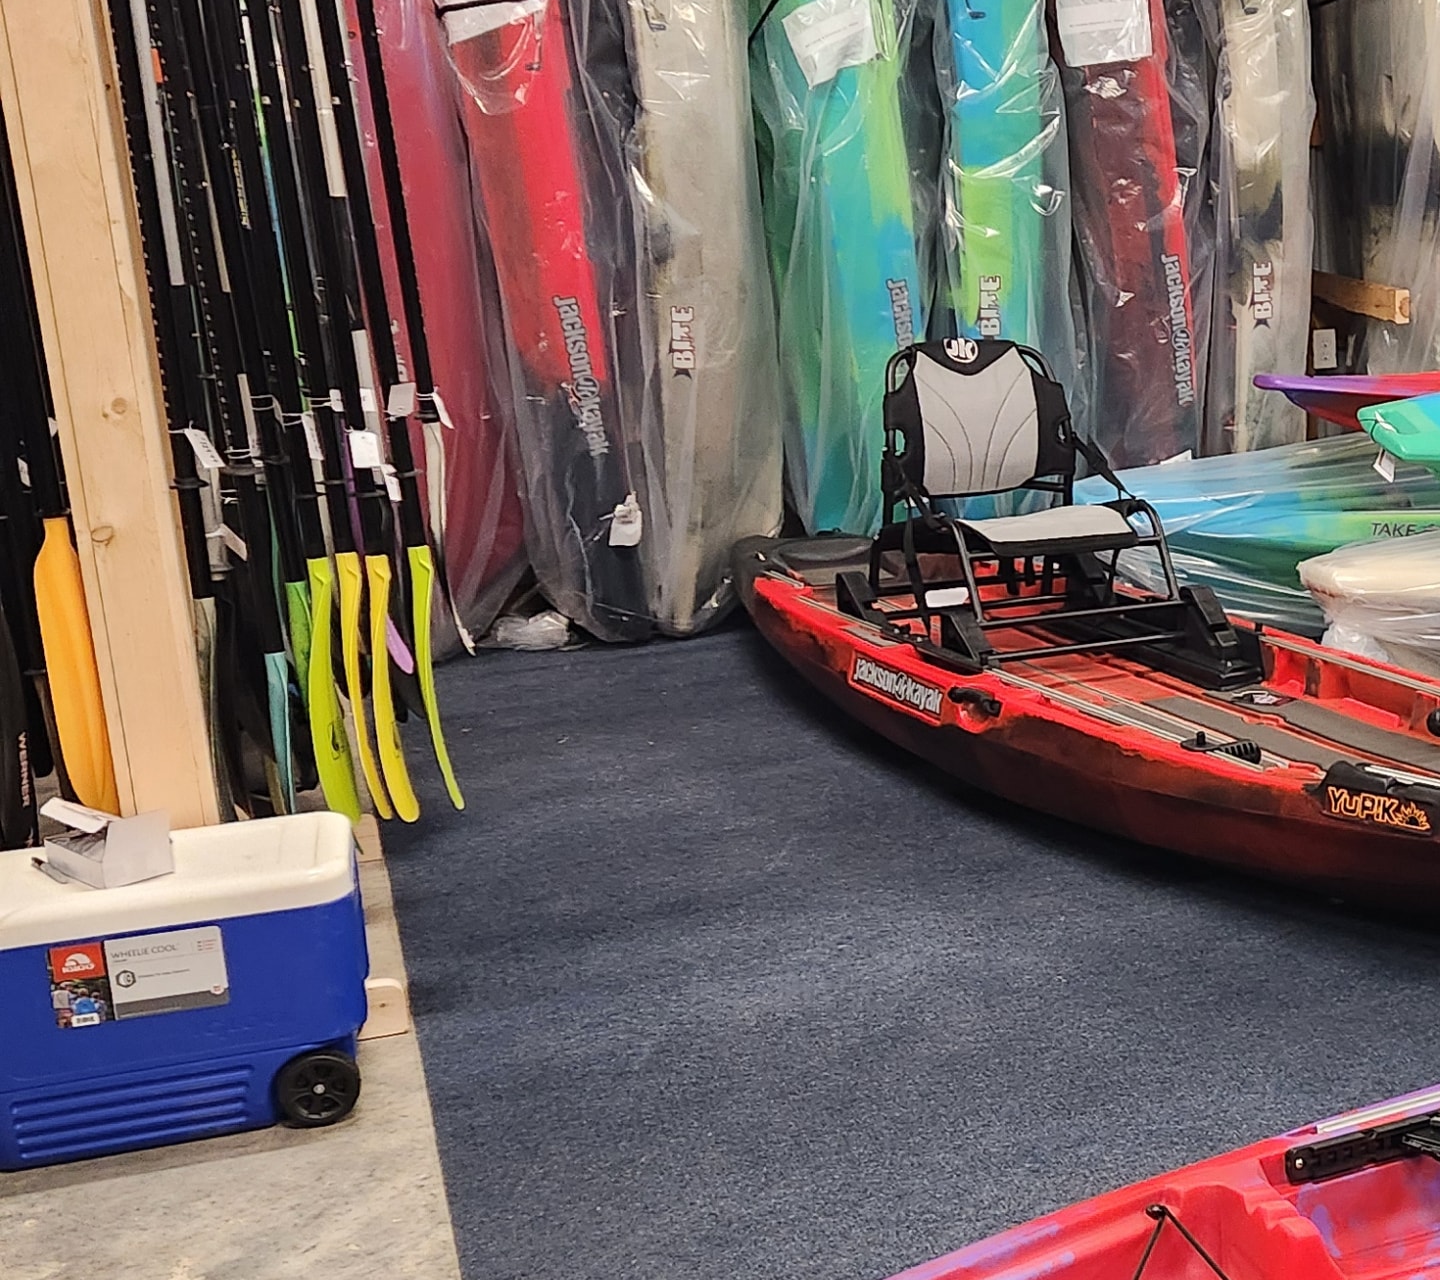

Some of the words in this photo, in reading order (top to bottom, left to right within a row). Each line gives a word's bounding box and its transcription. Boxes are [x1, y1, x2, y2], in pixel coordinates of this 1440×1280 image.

[979, 275, 1002, 336] BITE
[1252, 261, 1273, 320] BITE
[669, 305, 696, 370] BITE
[1371, 522, 1416, 537] TAKE
[17, 731, 31, 808] WERNER
[1327, 786, 1401, 824] YUPIK
[110, 947, 149, 959] WHEELIE
[151, 943, 177, 955] COOL
